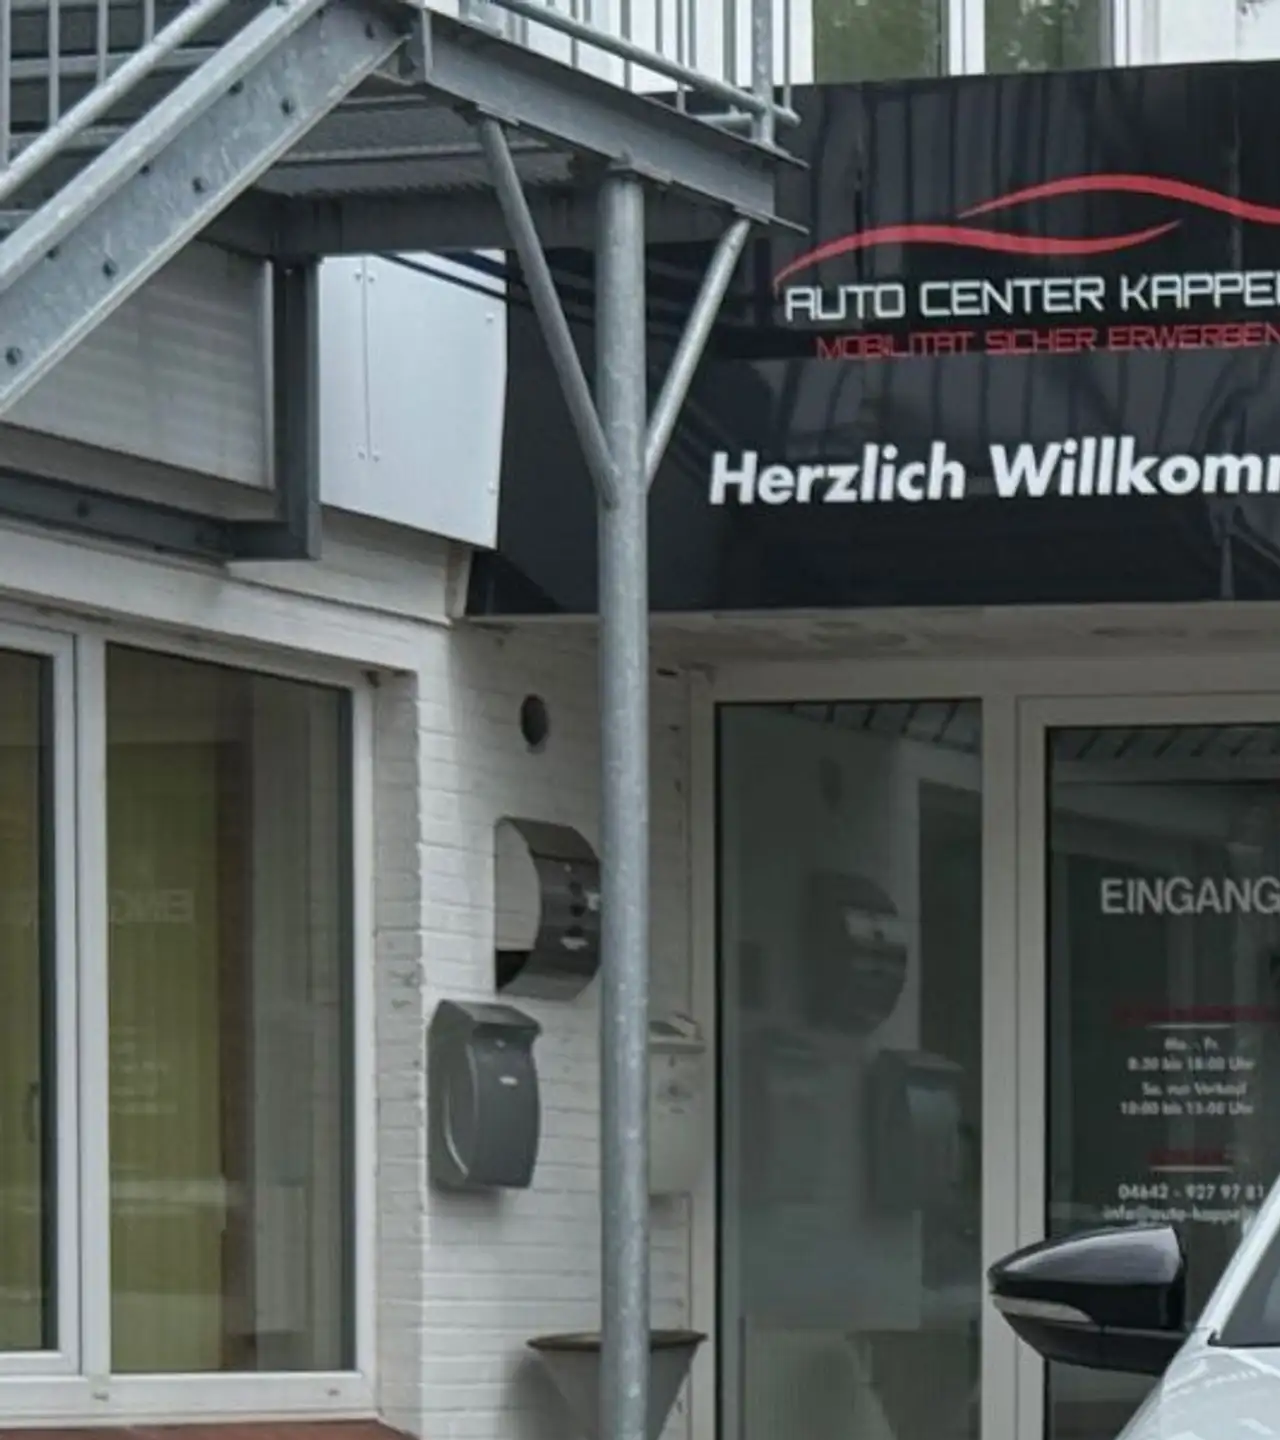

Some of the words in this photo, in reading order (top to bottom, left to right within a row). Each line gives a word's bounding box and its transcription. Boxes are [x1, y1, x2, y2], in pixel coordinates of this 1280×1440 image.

[786, 281, 905, 322] AUTO
[919, 275, 1105, 316] CENTER
[985, 328, 1097, 356] SICHER
[709, 442, 966, 504] Herzlich
